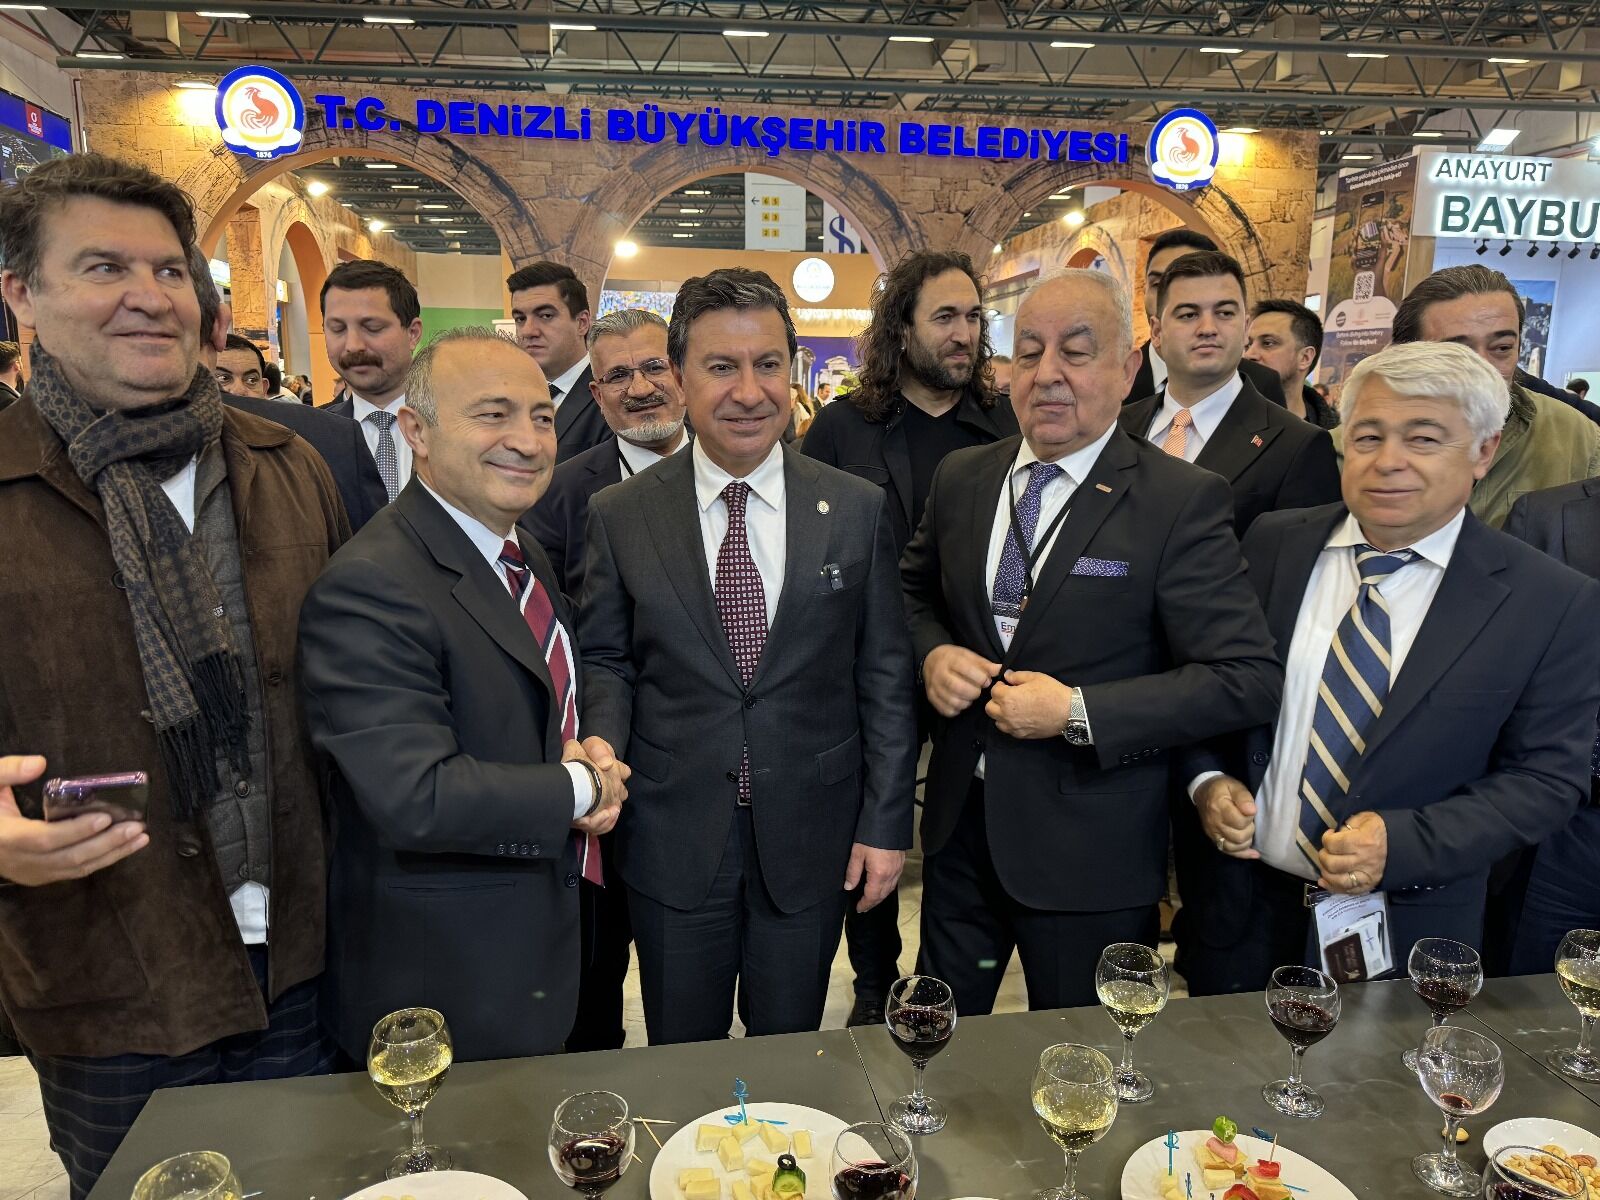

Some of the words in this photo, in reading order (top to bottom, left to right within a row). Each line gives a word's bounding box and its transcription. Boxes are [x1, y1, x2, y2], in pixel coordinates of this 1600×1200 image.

[315, 94, 401, 132] T.C.
[255, 151, 273, 159] 1876
[1435, 158, 1553, 182] ANAYURT
[1440, 195, 1600, 239] BAYBU
